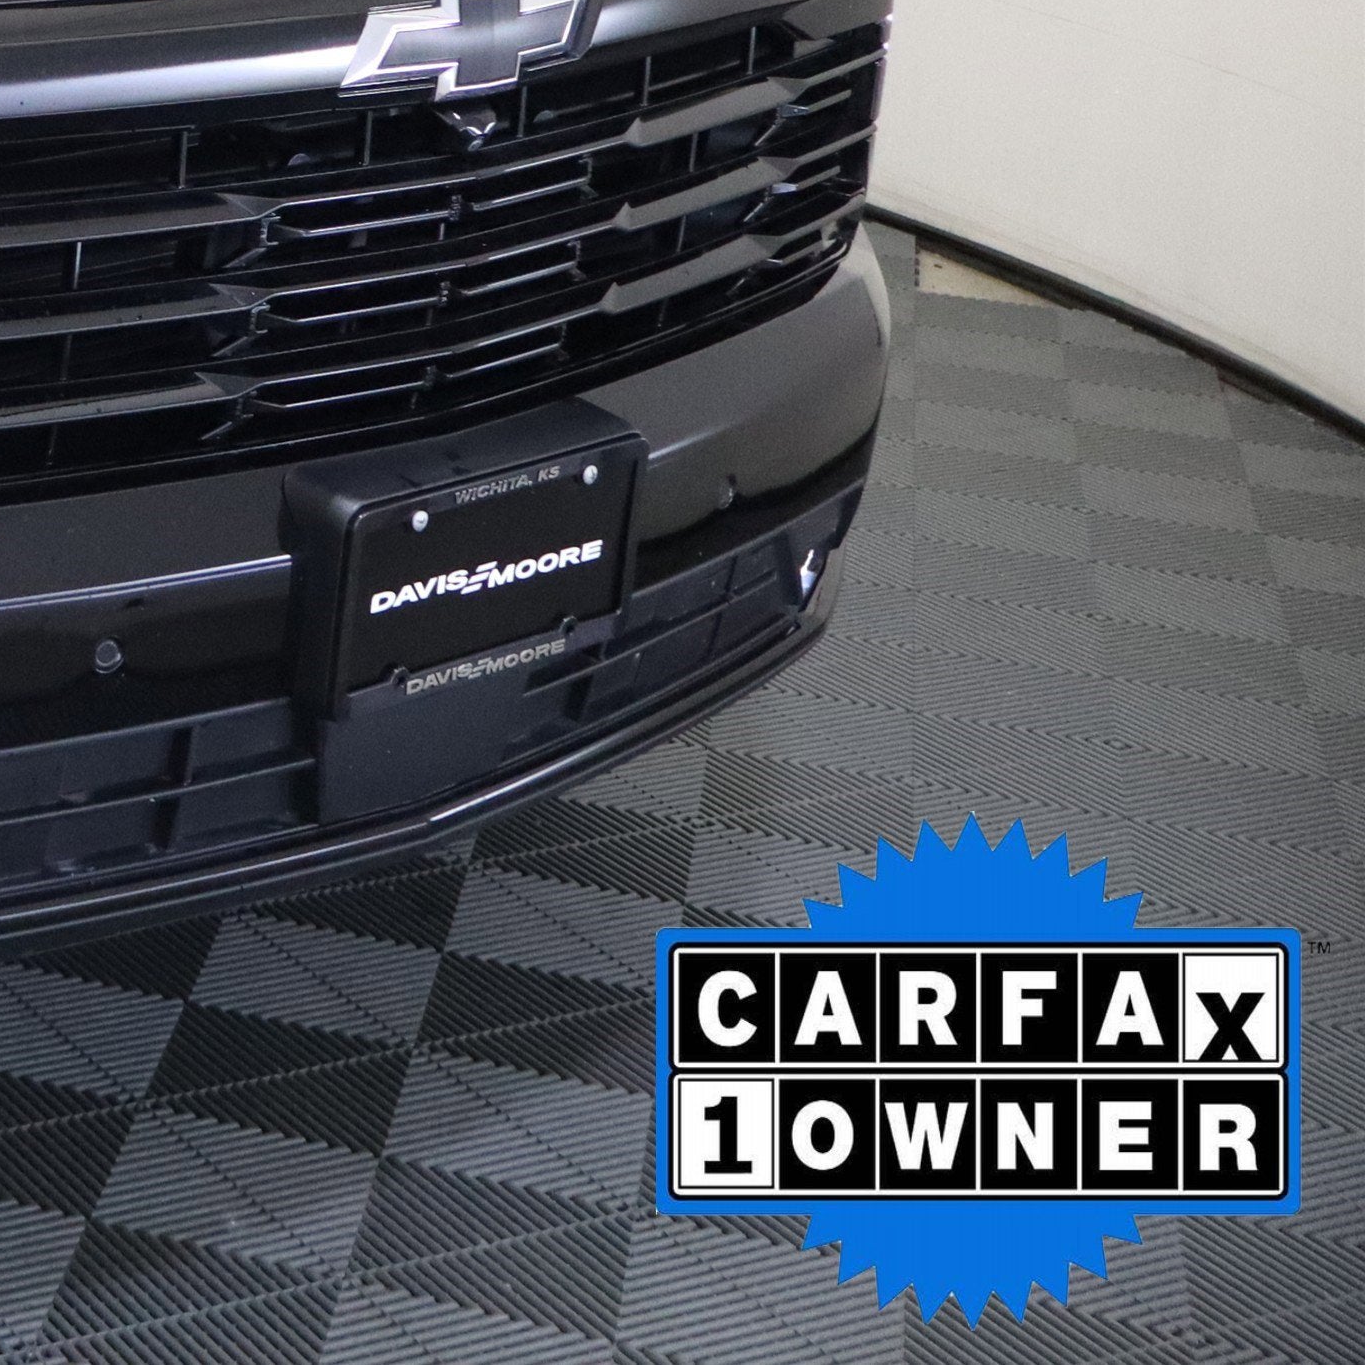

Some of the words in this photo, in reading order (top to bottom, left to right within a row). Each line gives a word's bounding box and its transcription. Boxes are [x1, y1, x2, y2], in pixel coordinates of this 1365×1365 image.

[538, 465, 561, 483] KS
[370, 568, 469, 614] DAVIS
[487, 539, 604, 589] MOORE
[405, 662, 473, 696] DAVIS
[486, 638, 566, 675] MOORE
